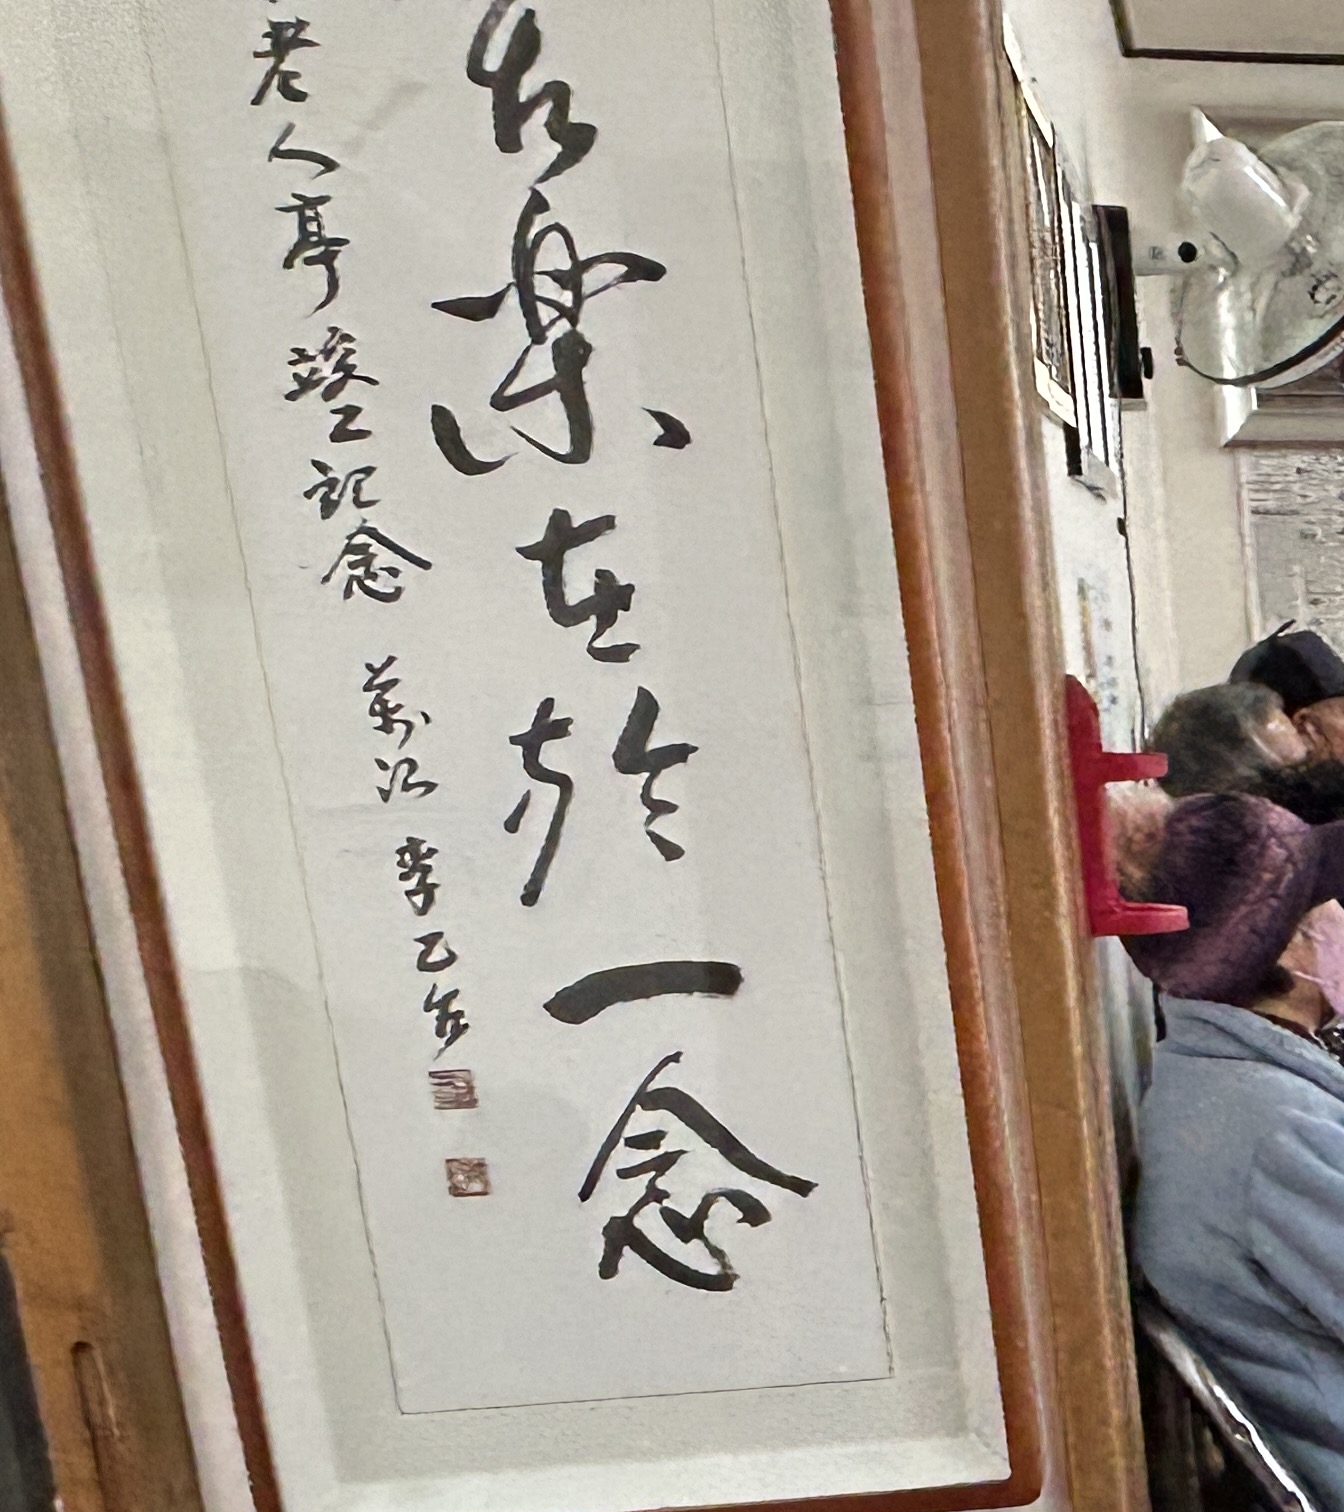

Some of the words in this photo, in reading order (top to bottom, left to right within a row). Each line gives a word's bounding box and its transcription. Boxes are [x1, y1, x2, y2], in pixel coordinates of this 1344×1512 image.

[250, 0, 432, 604] 老人亭竣工記念
